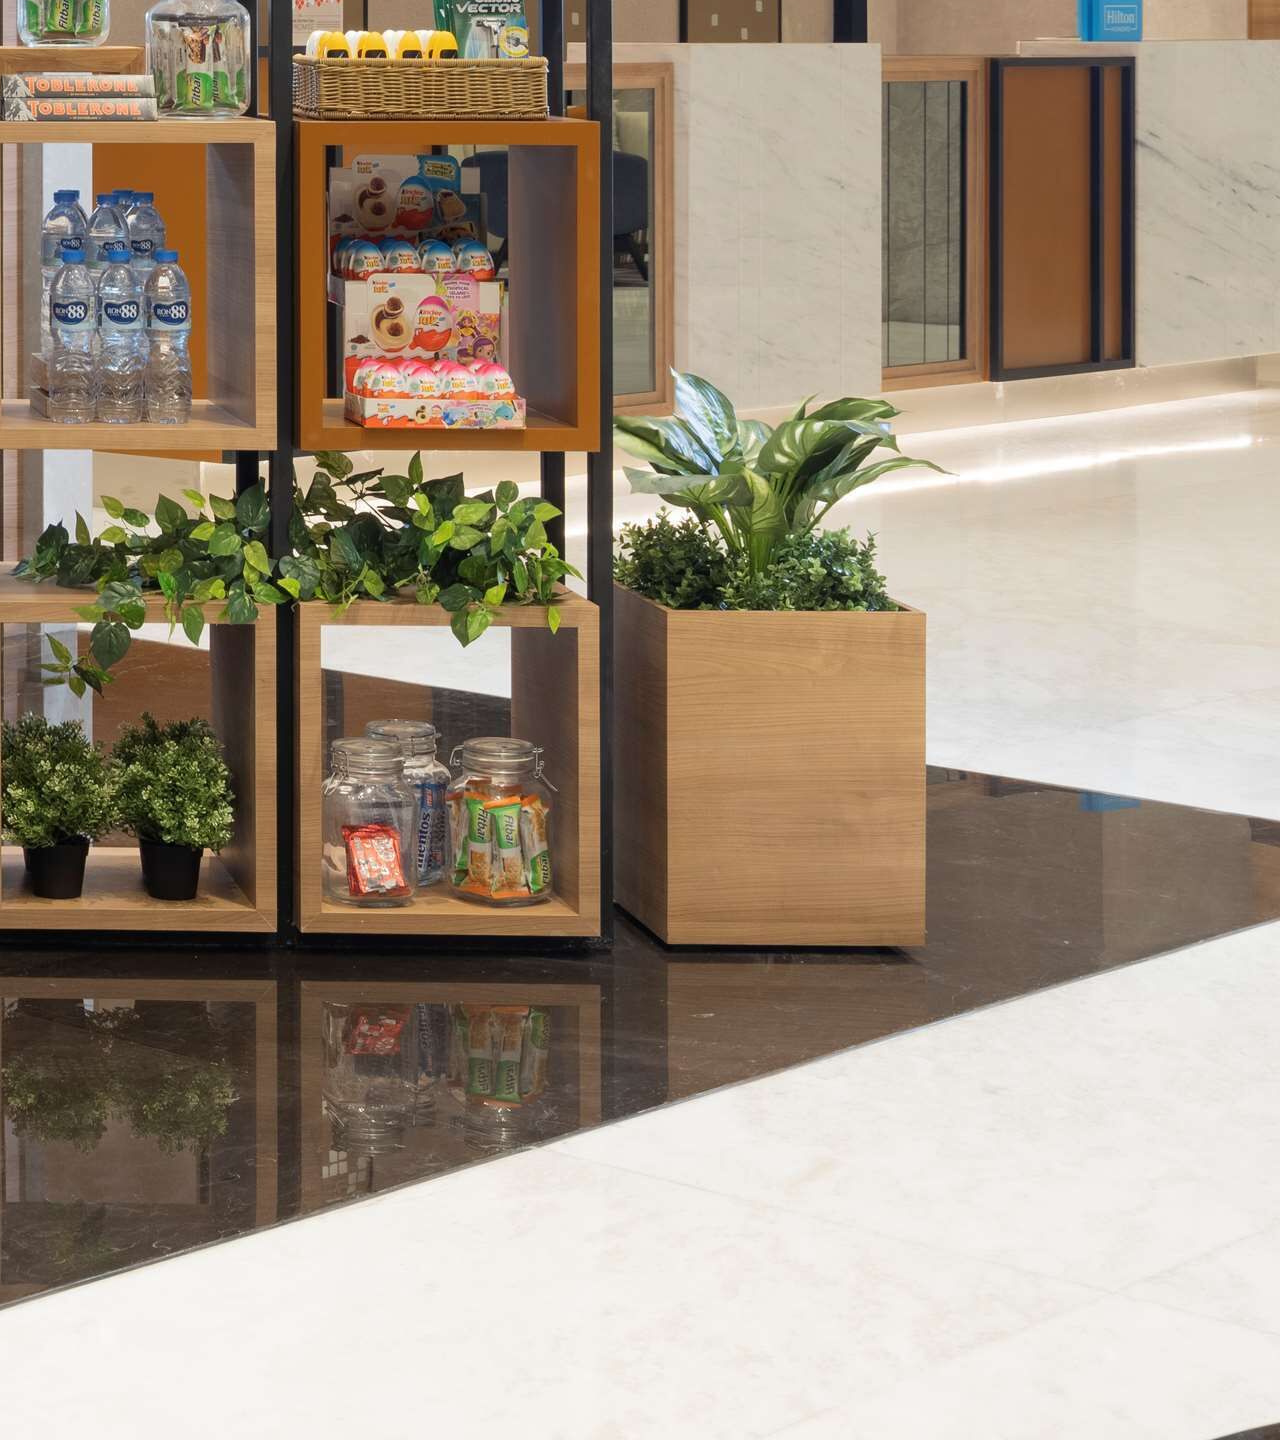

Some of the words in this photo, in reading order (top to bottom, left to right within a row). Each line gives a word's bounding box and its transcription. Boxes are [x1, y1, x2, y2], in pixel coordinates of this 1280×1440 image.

[455, 1, 521, 13] VECTOR
[1106, 8, 1135, 25] Hilton
[25, 75, 138, 92] TOBLERONE
[191, 75, 202, 108] Fitbar
[28, 100, 142, 117] TOBLERONE
[476, 807, 489, 842] Fitbar
[503, 813, 514, 848] Fitbar
